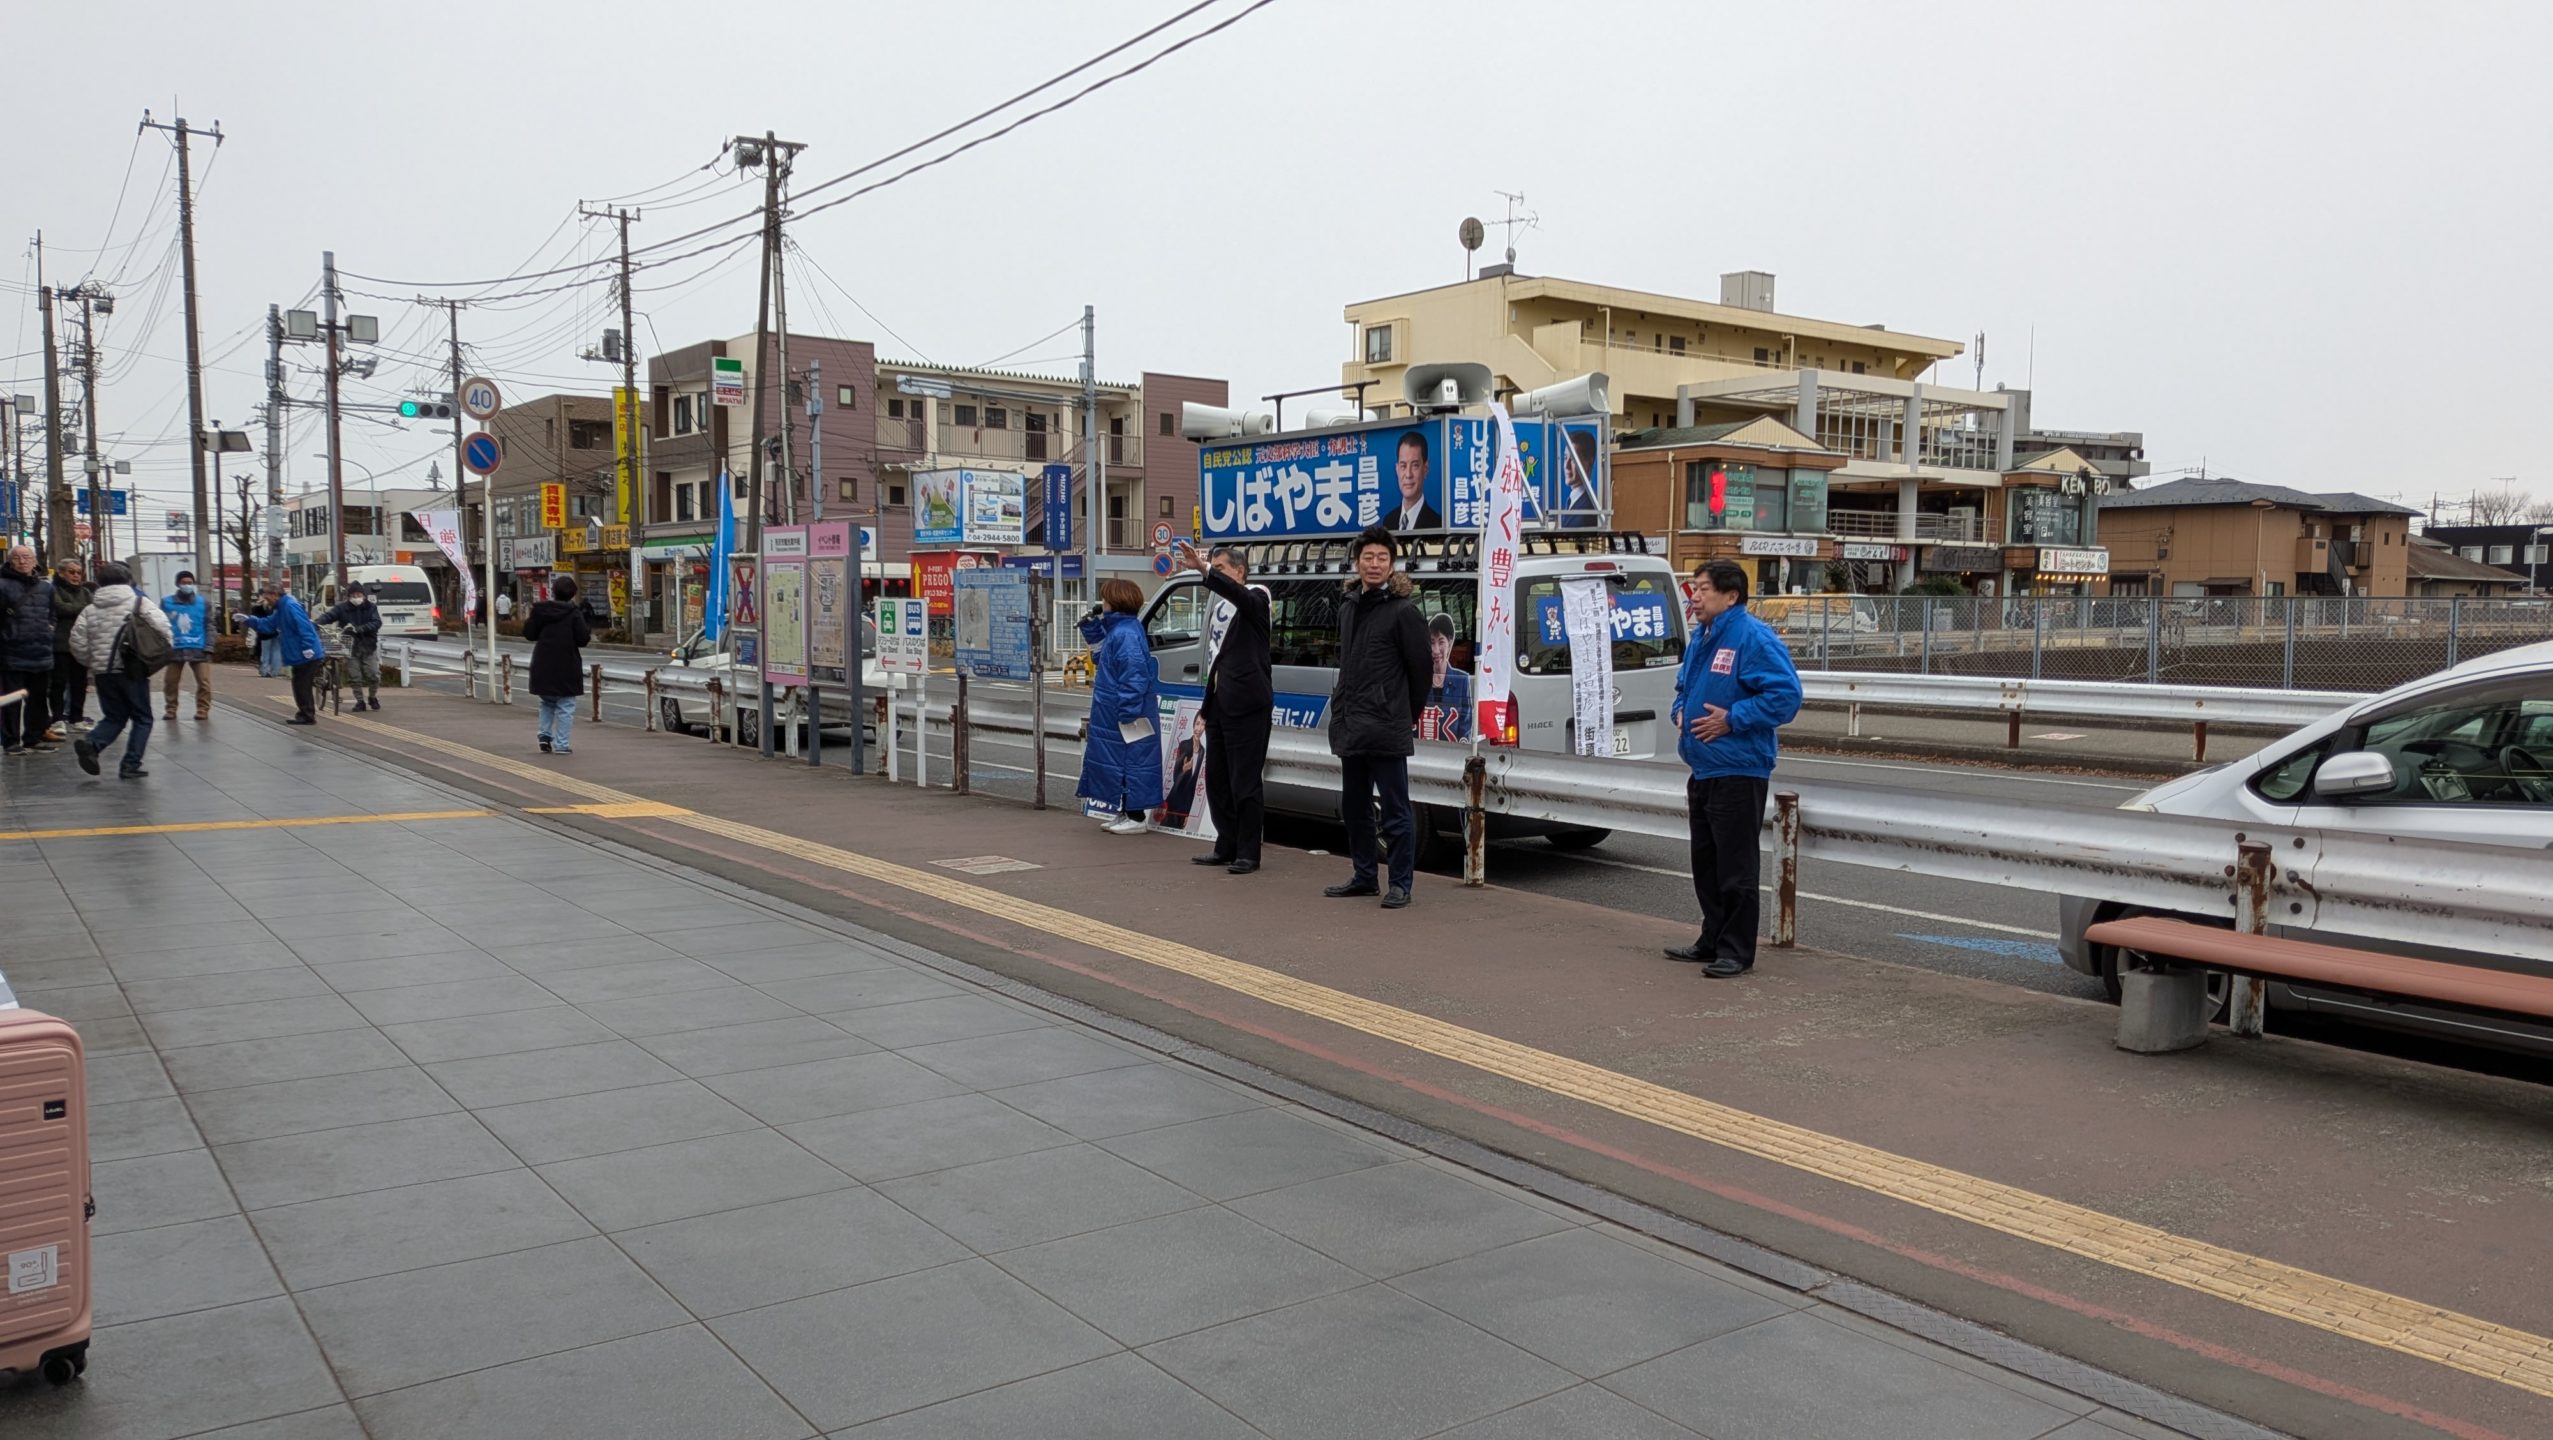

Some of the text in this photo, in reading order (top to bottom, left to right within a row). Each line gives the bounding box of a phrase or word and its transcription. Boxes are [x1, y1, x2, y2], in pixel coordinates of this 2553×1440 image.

[470, 389, 491, 409] 40
[1203, 447, 1253, 469] 自民党公認
[1203, 459, 1354, 534] しばやま
[1357, 455, 1381, 527] 昌彦
[1454, 477, 1469, 525] 昌彦
[2022, 496, 2034, 535] 美容室
[972, 534, 1020, 543] 04-2944-5800
[1157, 529, 1169, 540] 30
[922, 573, 949, 586] PREGO
[881, 603, 895, 612] TAXI
[907, 604, 920, 614] BUS
[1609, 607, 1653, 639] やま
[1527, 720, 1554, 730] HIACE
